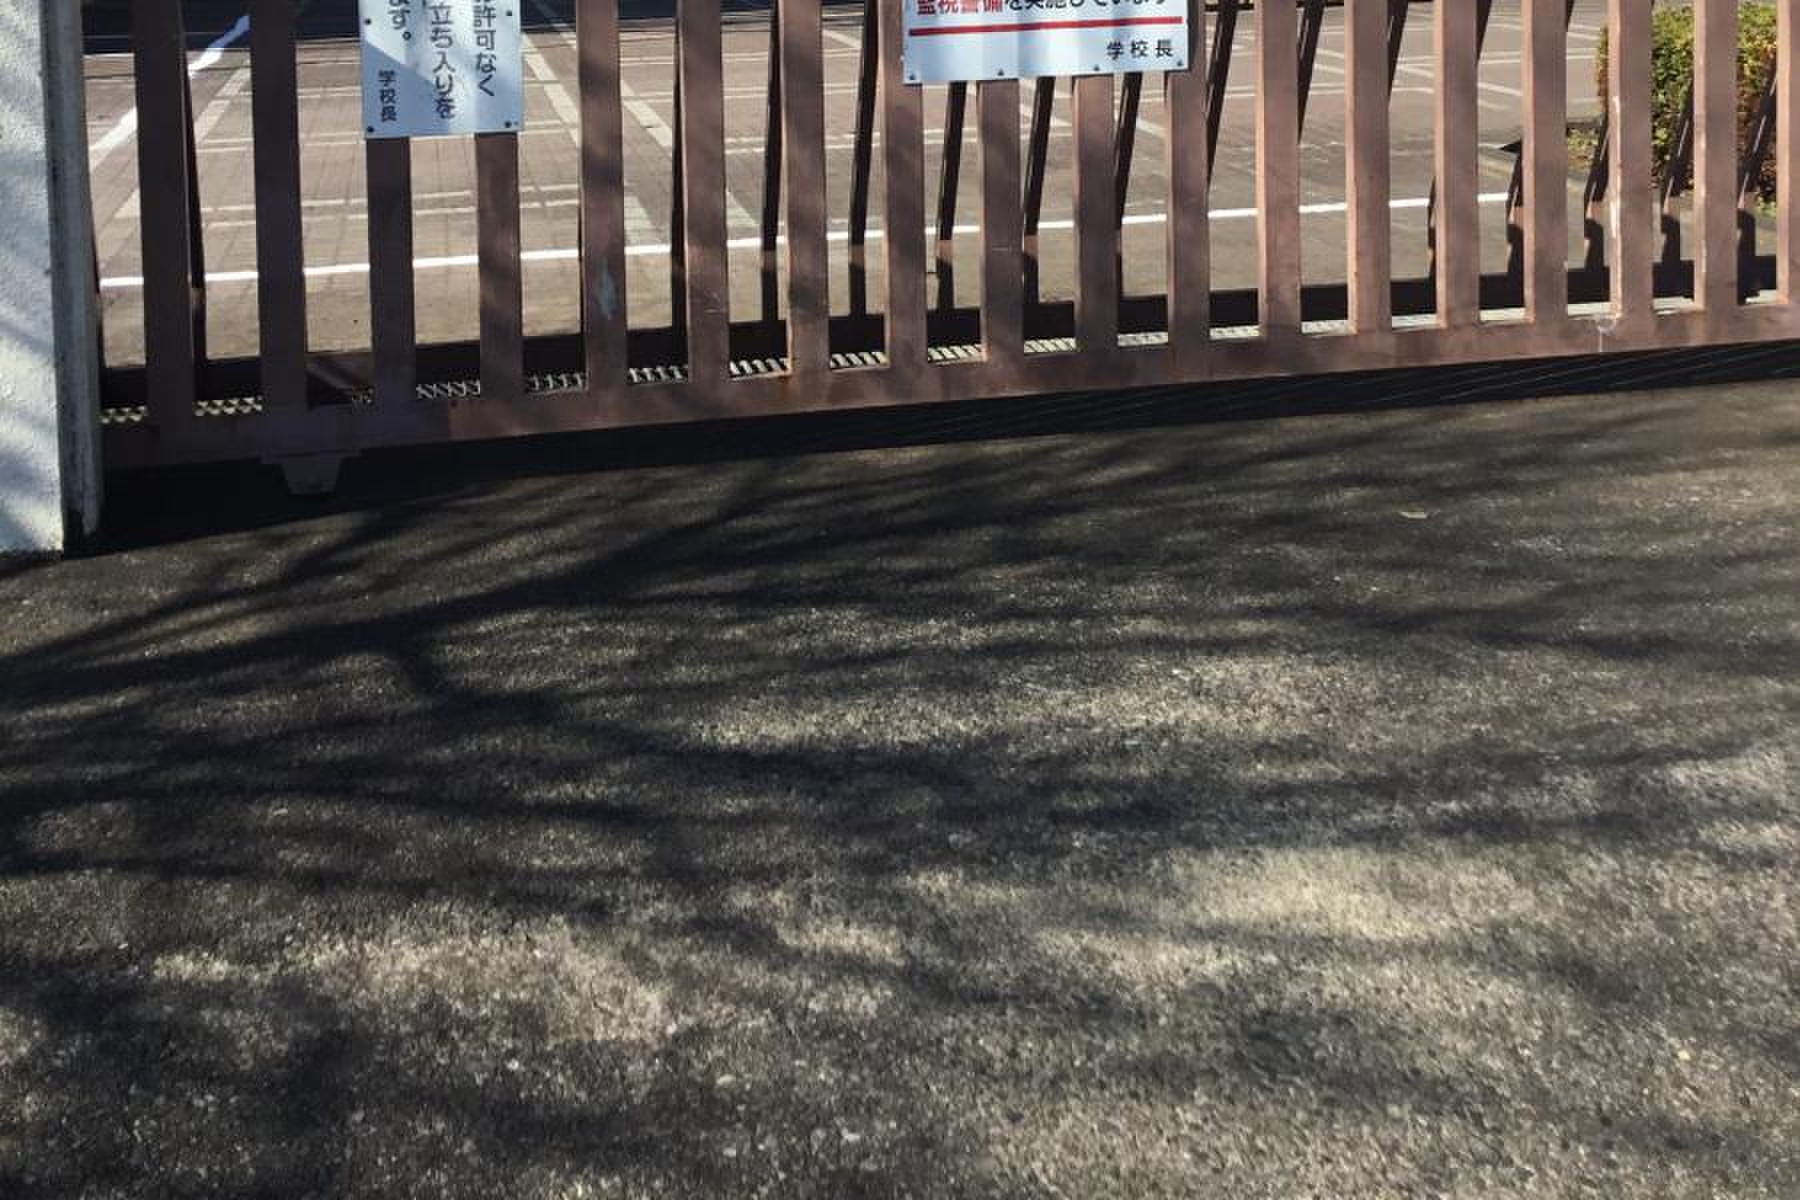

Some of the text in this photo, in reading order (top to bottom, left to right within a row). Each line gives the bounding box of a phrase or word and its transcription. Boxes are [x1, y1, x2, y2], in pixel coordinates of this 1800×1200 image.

[1107, 38, 1174, 61] 学校長
[378, 70, 397, 122] 学校長
